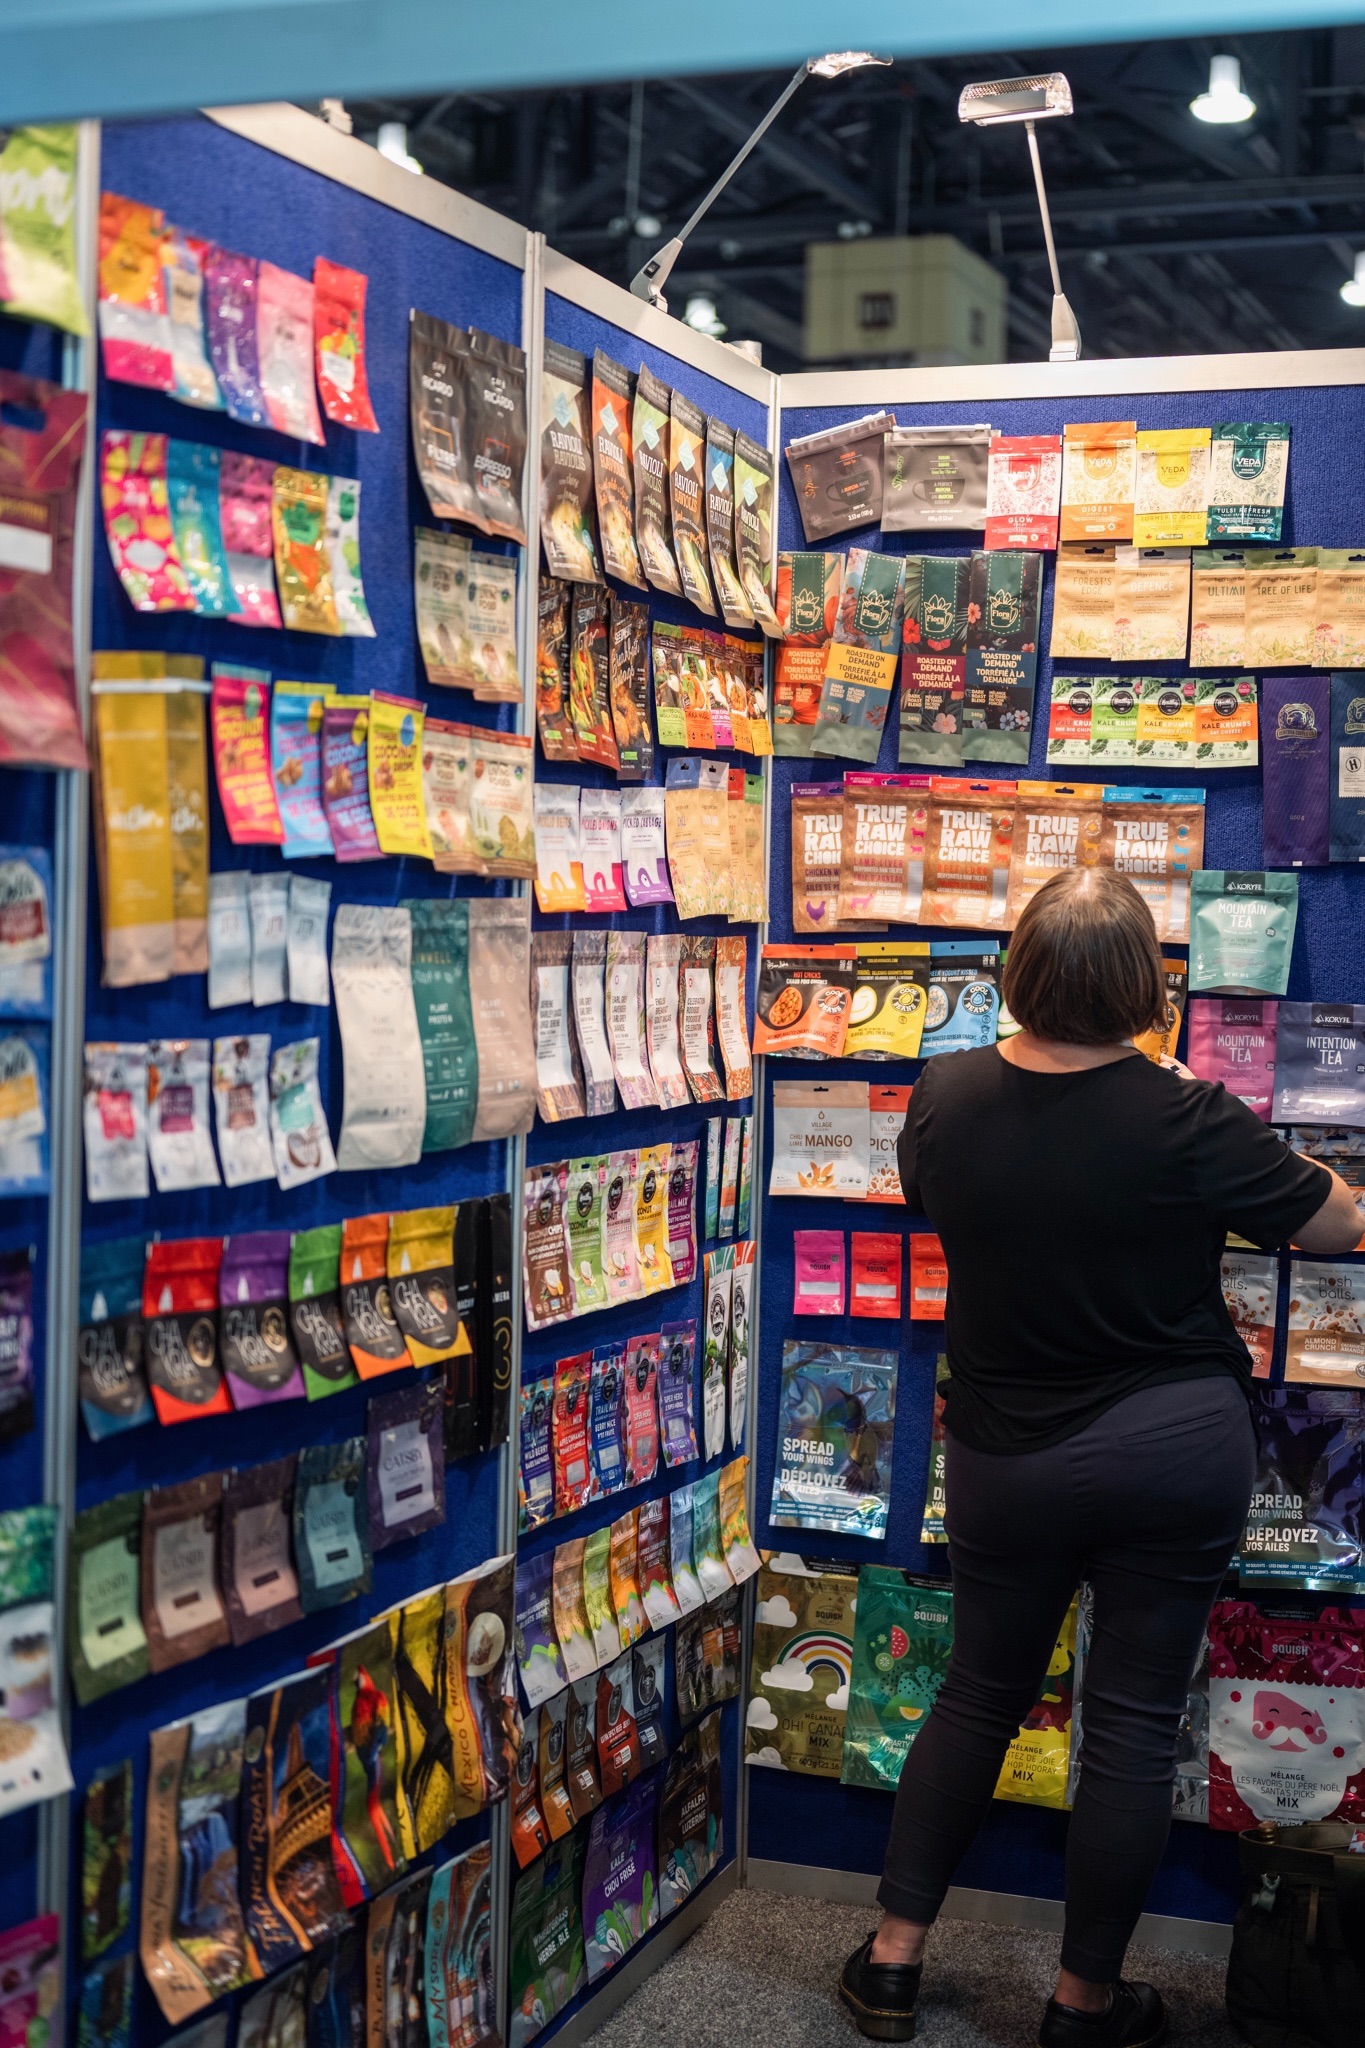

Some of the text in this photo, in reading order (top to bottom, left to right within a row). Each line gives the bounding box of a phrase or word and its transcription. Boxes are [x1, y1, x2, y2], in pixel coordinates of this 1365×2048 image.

[550, 431, 583, 455] RAVIOLI
[598, 436, 624, 465] RAVIOLI
[473, 454, 512, 479] ESPRESSO
[1236, 457, 1261, 466] VEDA
[1161, 466, 1186, 474] VEDA
[674, 472, 699, 499] RAVIOLI
[709, 494, 733, 516] RAVIOLI
[1081, 505, 1114, 513] DIGEST
[1008, 516, 1033, 524] GLOW
[1073, 577, 1112, 586] FOREST'S
[1130, 581, 1174, 592] DEFENCE
[1081, 586, 1102, 595] EDGE
[1257, 584, 1312, 596] TREE OF LIFE
[992, 610, 1010, 618] Flora
[788, 651, 825, 659] ROASTED ON
[791, 657, 821, 665] DEMAND
[846, 649, 885, 662] ROASTED ON
[917, 656, 957, 666] ROASTED ON
[981, 652, 1022, 661] ROASTED ON
[848, 656, 880, 669] DEMAND
[920, 664, 953, 673] DEMAND
[984, 659, 1017, 668] DEMAND
[790, 673, 822, 681] DEMANDE
[844, 672, 878, 685] DEMANDE
[983, 676, 1017, 685] DEMANDE
[919, 679, 953, 689] DEMANDE
[1349, 758, 1358, 771] H
[854, 803, 907, 824] TRUE
[939, 810, 992, 831] TRUE
[1026, 814, 1080, 835] TRUE
[855, 822, 907, 841] RAW
[1113, 821, 1169, 841] TRUE
[940, 828, 992, 849] RAW
[1026, 833, 1077, 854] RAW
[854, 840, 905, 856] CHOICE
[1114, 840, 1168, 859] RAW
[938, 847, 990, 864] CHOICE
[1025, 854, 1077, 869] CHOICE
[853, 858, 876, 867] LAMB
[1114, 858, 1167, 874] CHOICE
[805, 868, 833, 877] CHICKEN
[1236, 883, 1263, 891] KORYFE
[1218, 903, 1267, 916] MOUNTAIN
[1230, 914, 1252, 928] TEA
[803, 971, 822, 979] CHICKS
[825, 990, 844, 998] COOL
[900, 987, 918, 996] COOL
[969, 986, 989, 996] COOL
[819, 1002, 842, 1013] BEANS
[893, 1001, 917, 1012] BEANS
[964, 1001, 989, 1013] BEANS
[1325, 1015, 1351, 1024] KORYFE
[1217, 1034, 1265, 1048] MOUNTAIN
[1306, 1036, 1356, 1050] INTENTION
[1229, 1047, 1252, 1063] TEA
[1319, 1049, 1342, 1065] TEA
[789, 1133, 803, 1141] CHILI
[805, 1134, 853, 1148] MANGO
[678, 1197, 689, 1207] MIX
[810, 1263, 831, 1271] SQUISH
[866, 1265, 888, 1273] SQUISH
[1318, 1275, 1353, 1287] nosh
[1319, 1286, 1355, 1300] balls.
[1304, 1343, 1336, 1351] CRUNCH
[1340, 1346, 1365, 1355] AMANDE
[606, 1419, 616, 1428] NICE
[525, 1444, 549, 1459] WILD BERRY
[782, 1437, 835, 1457] SPREAD
[383, 1448, 424, 1472] GATSBY
[782, 1451, 835, 1467] YOUR WINGS
[780, 1466, 847, 1490] DÉPLOYEZ
[779, 1483, 796, 1493] VOS
[1250, 1493, 1303, 1510] SPREAD
[1247, 1508, 1303, 1520] YOUR WINGS
[1246, 1523, 1319, 1544] DÉPLOYEZ
[1246, 1541, 1290, 1552] VOS AILES
[815, 1609, 843, 1621] SQUISH
[913, 1610, 949, 1624] SQUISH
[1272, 1643, 1309, 1656] SQUISH
[805, 1712, 837, 1723] MÉLANGE
[781, 1717, 804, 1732] OH!
[809, 1735, 829, 1748] MIX
[1009, 1742, 1043, 1755] MÉLANGE
[1026, 1753, 1037, 1762] DE
[458, 1727, 481, 1802] MEXICO
[1007, 1760, 1057, 1774] HOP HOORAY
[1012, 1769, 1035, 1782] MIX
[1270, 1771, 1306, 1781] MÉLANGE
[1236, 1775, 1341, 1793] LES FAVORIS DU PÈRE NOËL
[1260, 1787, 1316, 1799] SANTA'S PICKS
[681, 1791, 707, 1818] ALFALFA
[1276, 1796, 1299, 1809] MIX
[681, 1811, 707, 1835] LUZERNE
[610, 1851, 626, 1873] KALE
[604, 1861, 637, 1898] CHOU FRISÉ
[532, 1906, 569, 1949] WHEATGRASS
[537, 1940, 557, 1967] HERBE
[427, 1936, 444, 2016] MYSORE
